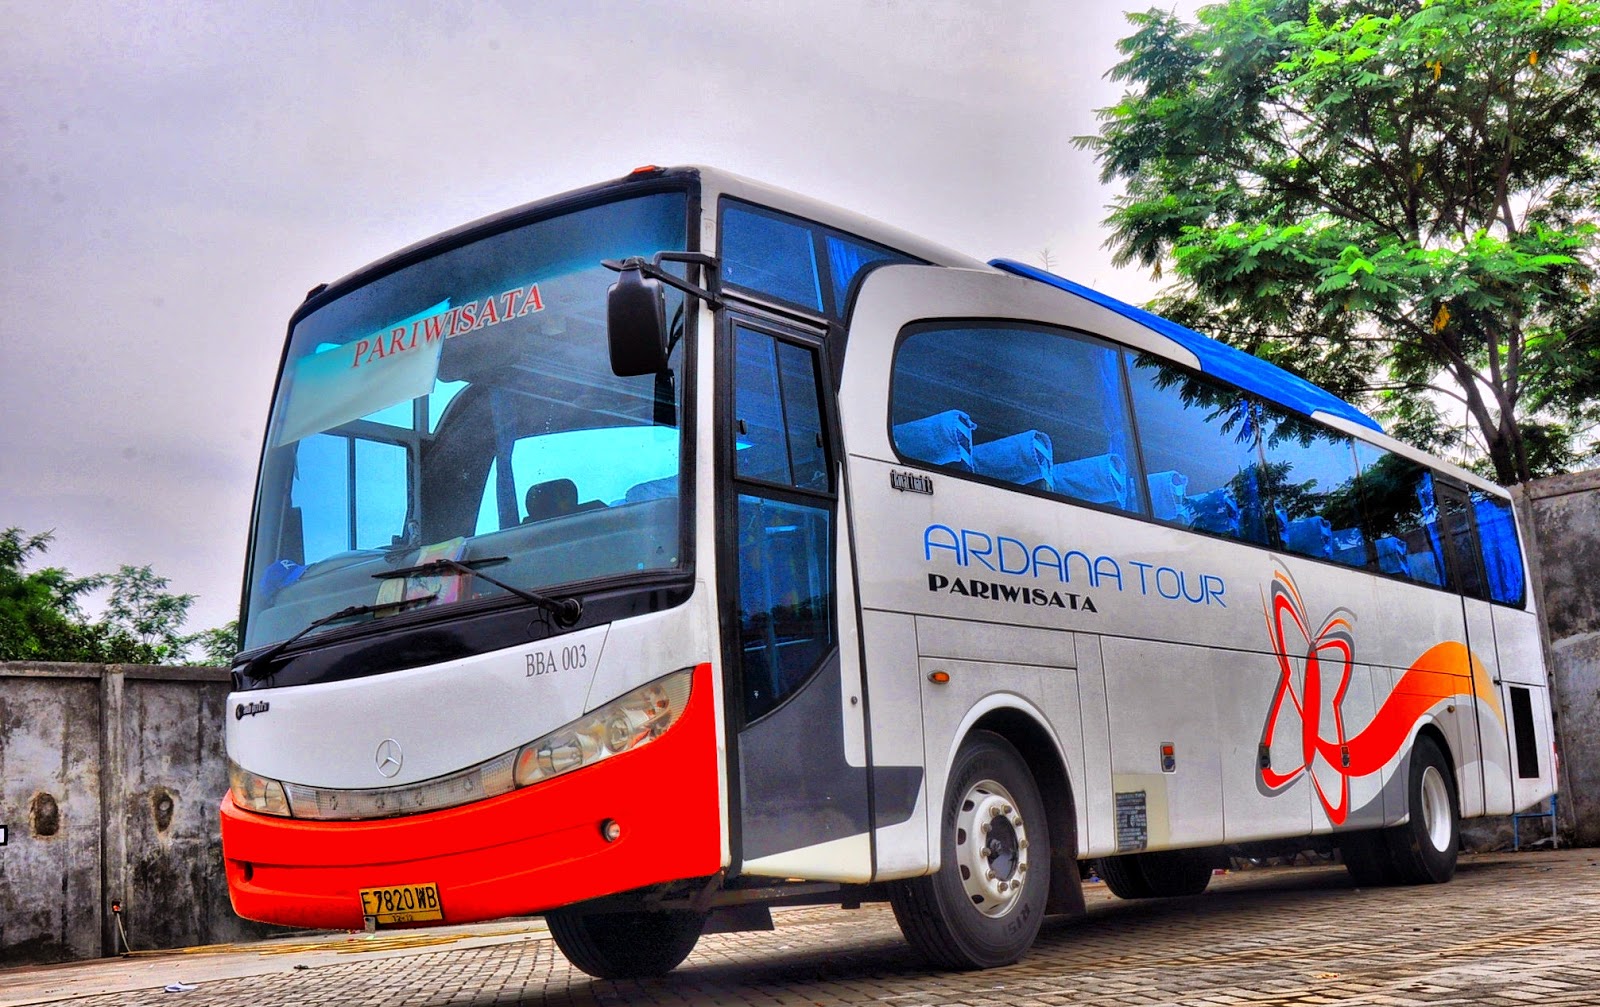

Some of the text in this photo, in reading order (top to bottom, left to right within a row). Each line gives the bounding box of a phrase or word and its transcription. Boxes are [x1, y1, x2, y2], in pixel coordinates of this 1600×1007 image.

[352, 282, 545, 368] PARIWISATA
[923, 523, 1227, 609] ARDANA TOUR
[928, 573, 1099, 614] PARIWISATA
[525, 644, 587, 678] BBA 003
[373, 887, 415, 914] 7820
[415, 886, 437, 909] WB
